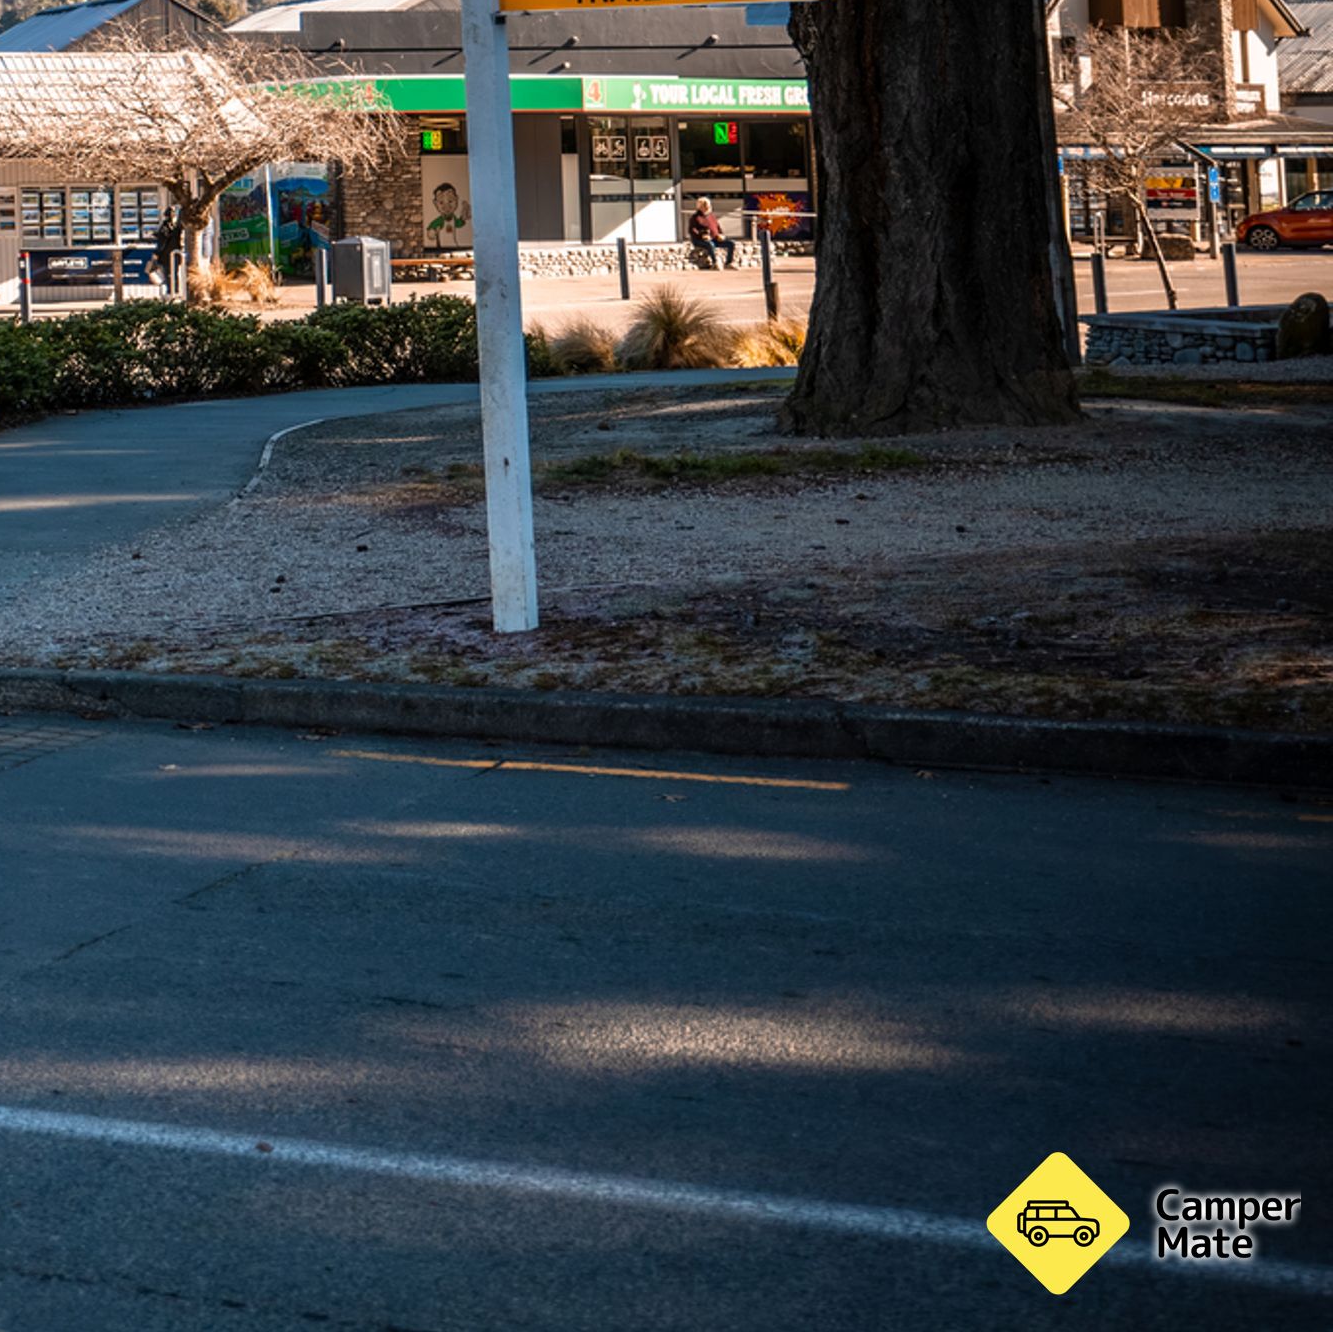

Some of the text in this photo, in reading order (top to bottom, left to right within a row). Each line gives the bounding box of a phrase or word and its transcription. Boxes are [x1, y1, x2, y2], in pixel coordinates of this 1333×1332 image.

[649, 83, 688, 105] YOUR
[691, 84, 736, 106] LOCAL
[738, 85, 781, 106] FRESH
